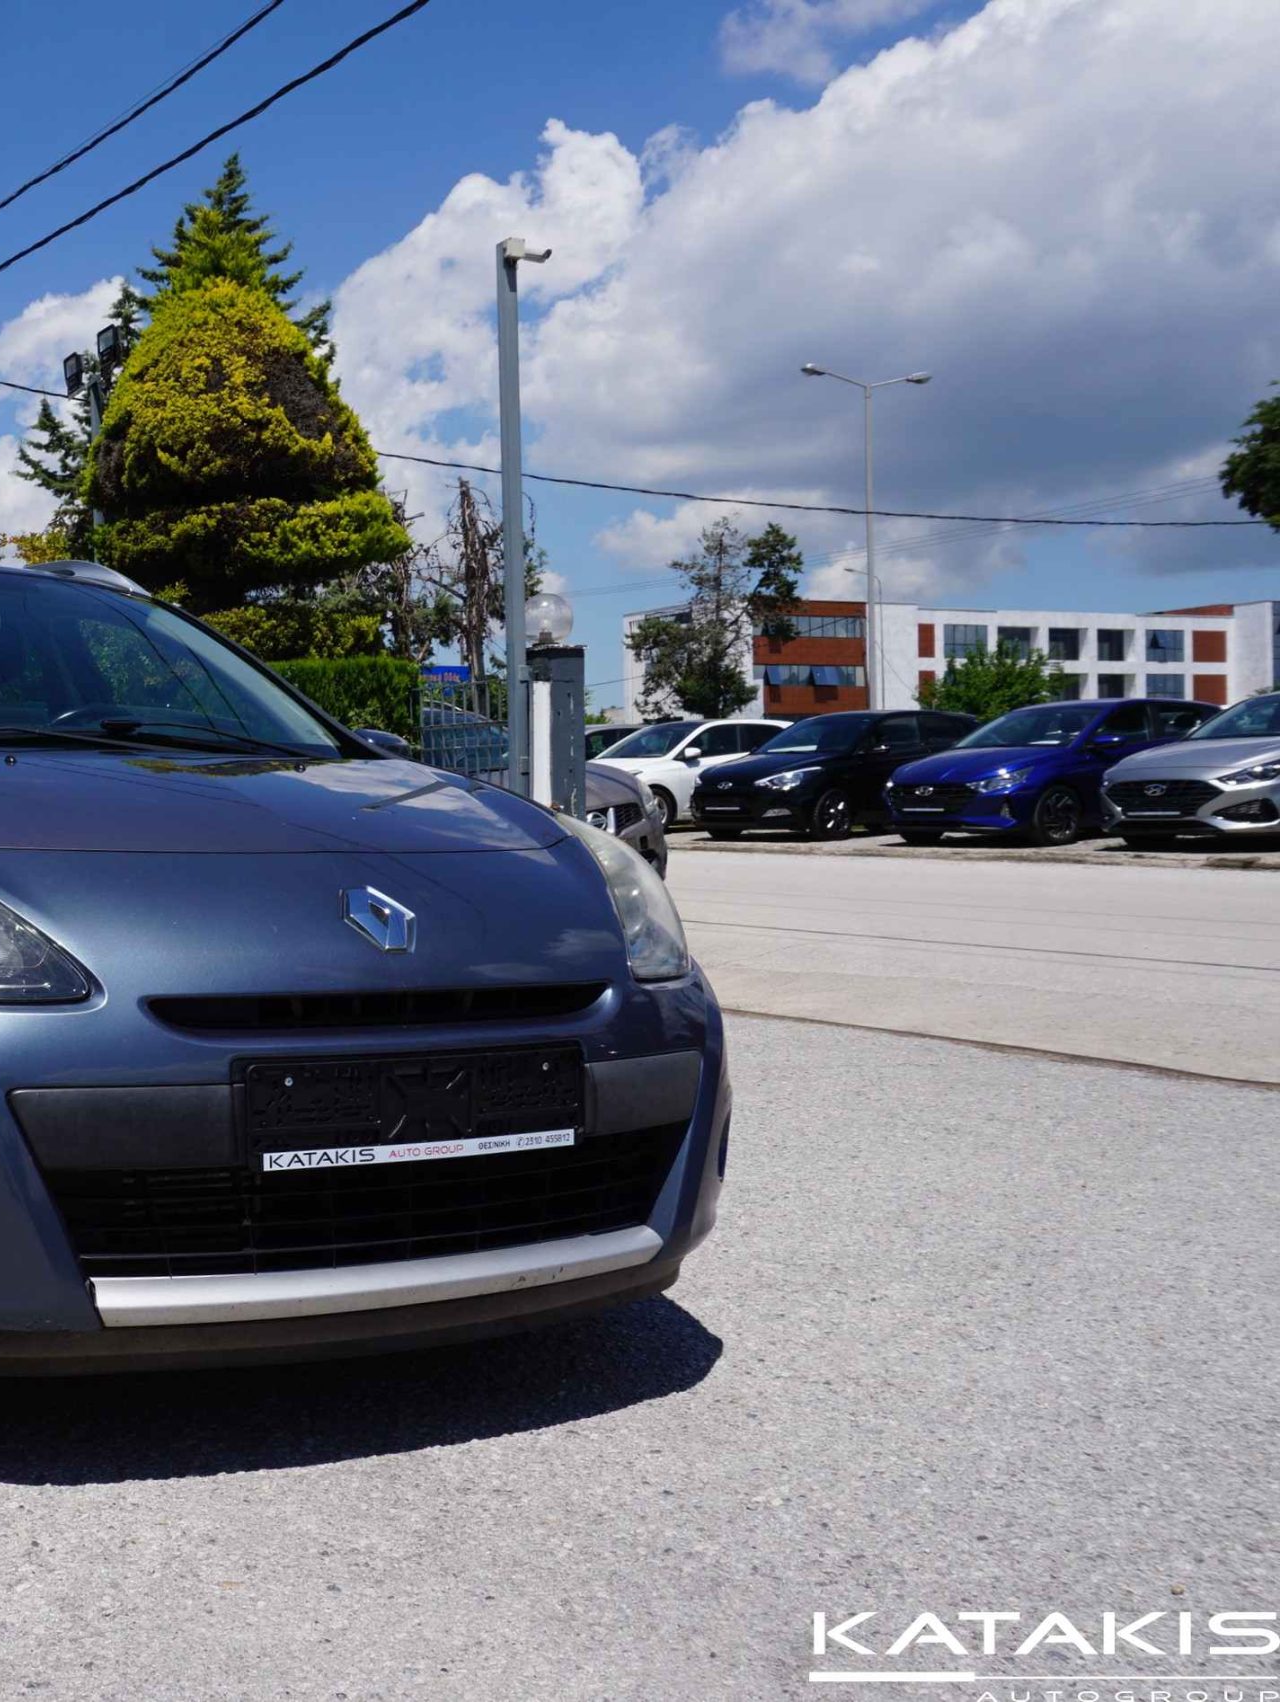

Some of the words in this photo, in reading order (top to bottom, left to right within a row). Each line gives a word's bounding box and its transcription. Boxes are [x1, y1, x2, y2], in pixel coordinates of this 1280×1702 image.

[269, 1148, 376, 1169] KATAKIS
[388, 1146, 421, 1159] AUTO
[424, 1143, 465, 1157] GROUP
